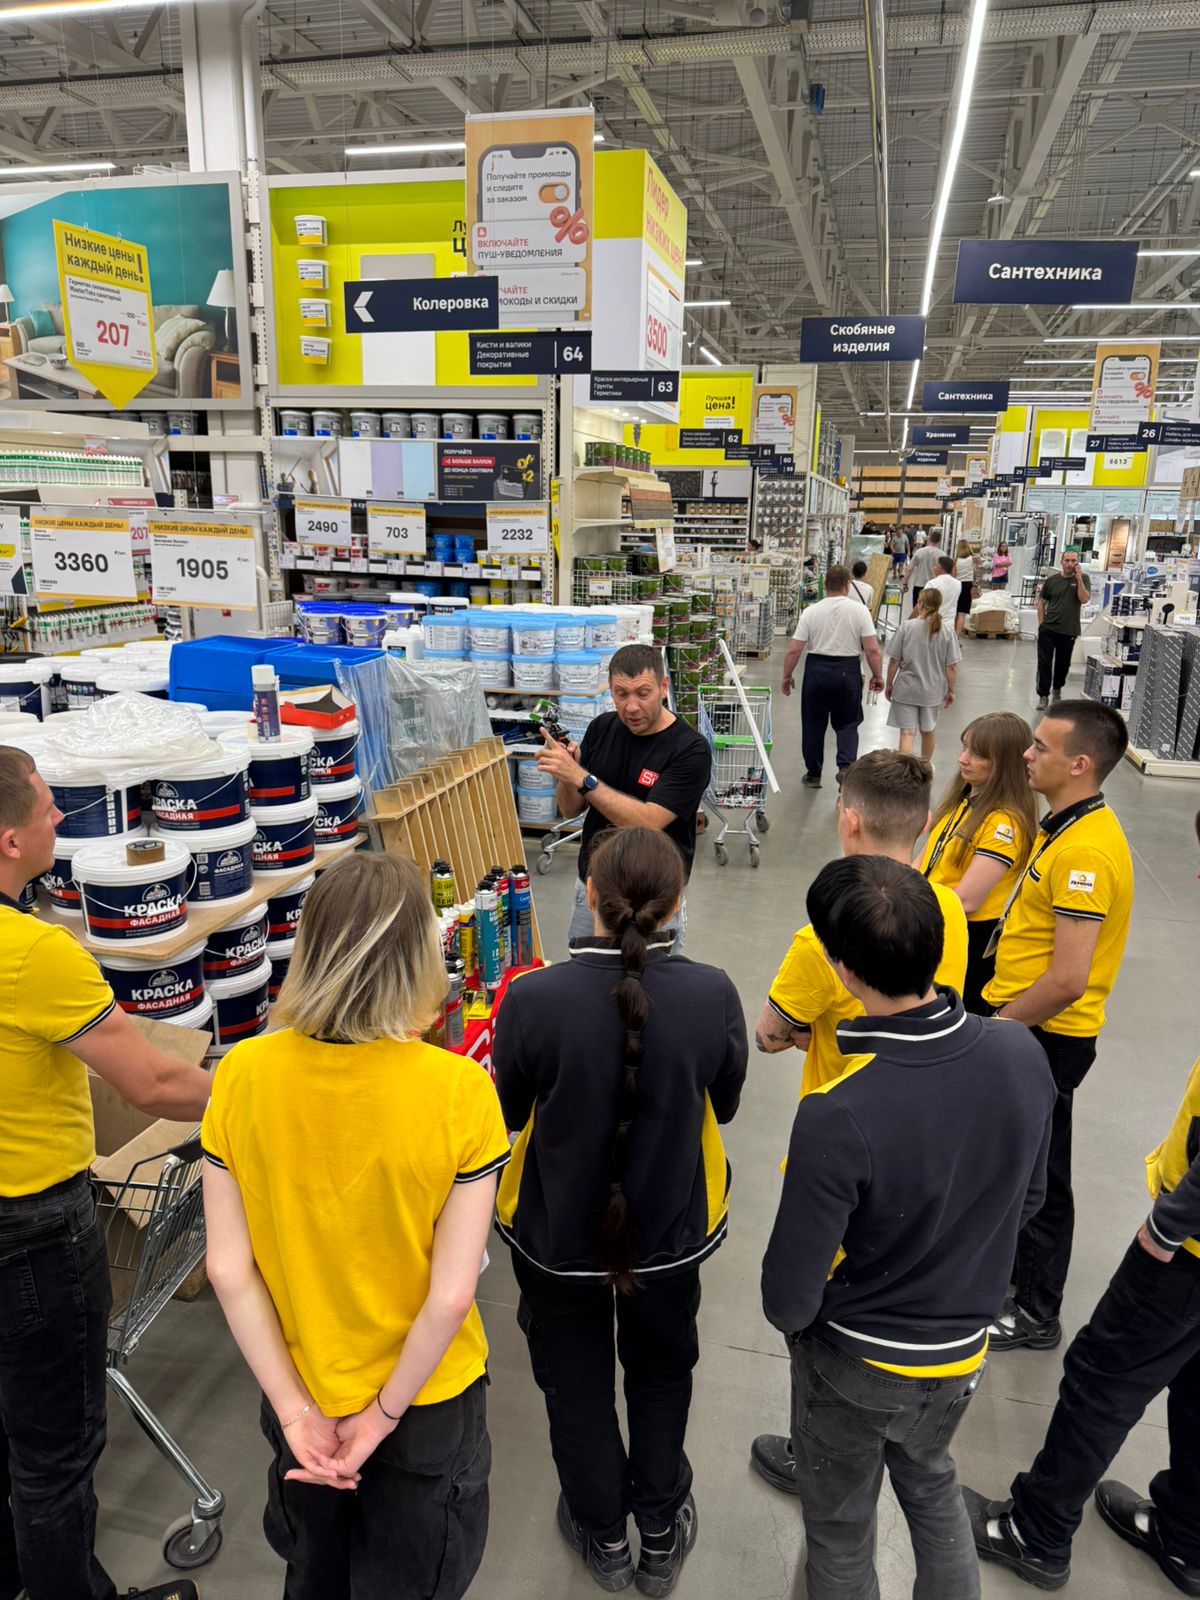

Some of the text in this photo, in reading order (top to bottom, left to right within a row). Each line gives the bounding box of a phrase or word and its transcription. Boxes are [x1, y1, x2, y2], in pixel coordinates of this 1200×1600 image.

[486, 170, 571, 181] Получайте промокоды
[493, 184, 523, 193] следите
[64, 232, 135, 263] Низкие цены
[478, 238, 529, 248] ВКЛЮЧАЙТЕ
[478, 248, 563, 259] ПУШ-УВЕДОМЛЕНИЯ
[67, 254, 113, 275] каждый
[988, 263, 1103, 282] Сантехника
[499, 285, 528, 295] ЧАЙТЕ
[413, 297, 489, 312] Колеровка
[543, 295, 578, 305] СКИДКИ
[96, 319, 129, 347] 207
[647, 313, 668, 358] 3500
[830, 323, 896, 336] Скобяные
[476, 341, 498, 349] Кисти
[832, 341, 891, 353] изделия
[476, 351, 530, 360] Декоративные
[563, 346, 583, 362] 64
[477, 361, 512, 370] покрытия
[657, 381, 673, 392] 63
[938, 391, 994, 400] Сантехника
[727, 435, 739, 443] 62
[1142, 429, 1156, 438] 26
[75, 520, 104, 528] КАЖДЫЙ
[308, 520, 338, 533] 2490
[131, 527, 148, 540] 207
[199, 526, 229, 534] КАЖДЫЙ
[229, 527, 248, 535] ДЕНЬ!
[386, 526, 408, 539] 703
[501, 528, 533, 540] 2232
[54, 551, 109, 573] 3360
[176, 558, 229, 580] 1905
[214, 863, 244, 874] ФАСАДНАЯ
[124, 893, 185, 918] КРАСКА
[130, 909, 181, 926] ФАСАДНАЯ
[131, 978, 194, 1001] КРАСКА
[137, 993, 191, 1010] ФАСАДНАЯ
